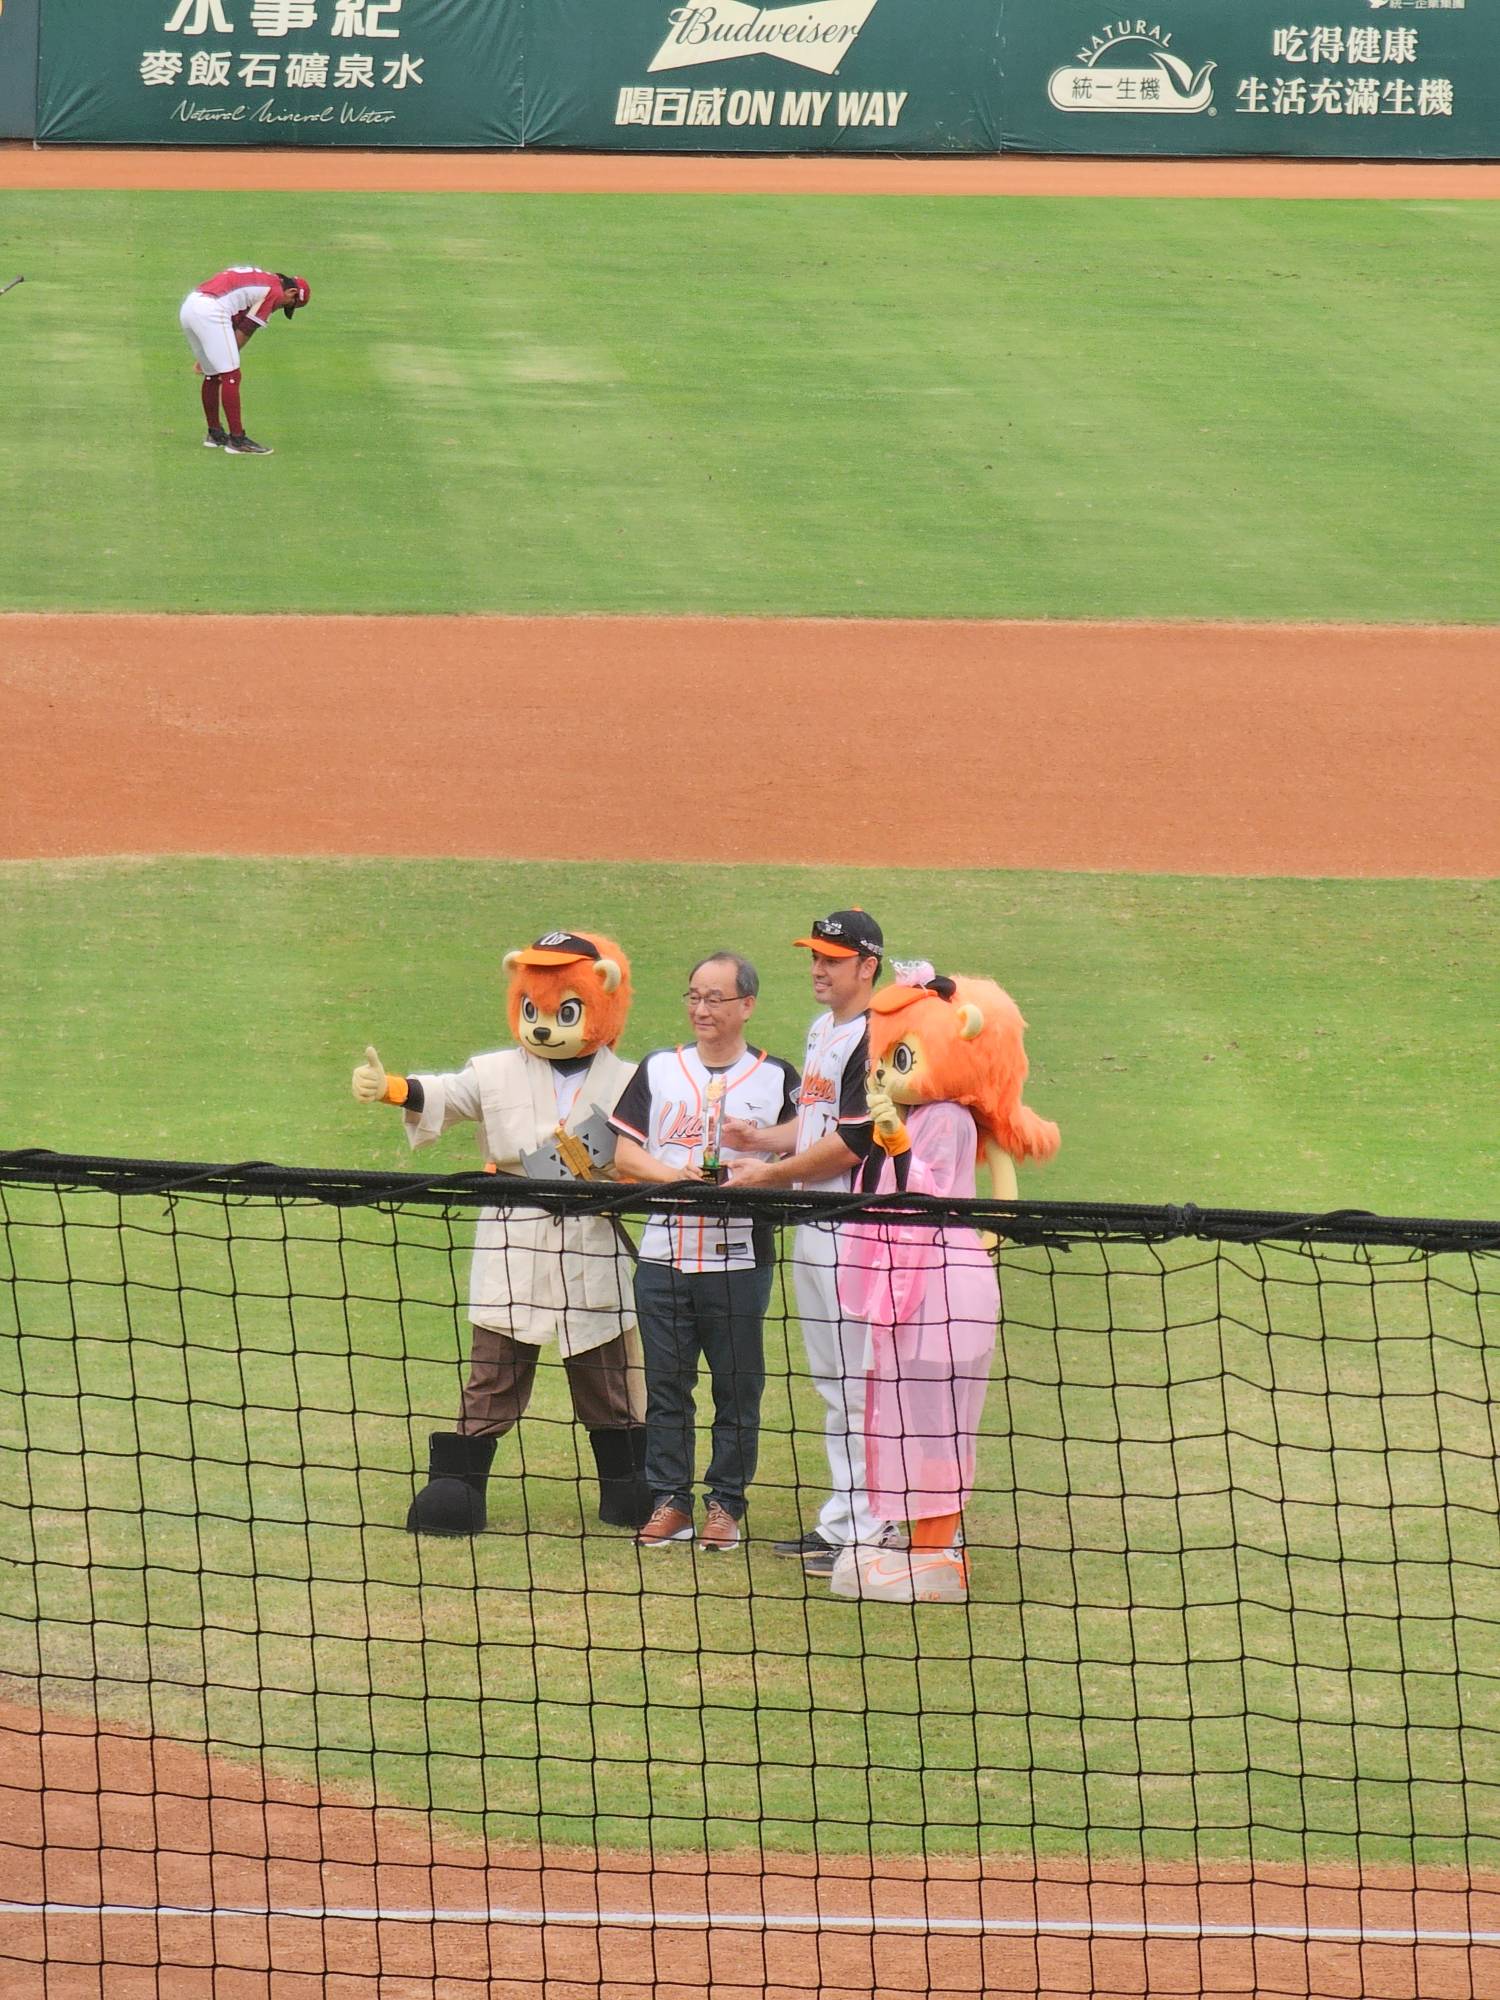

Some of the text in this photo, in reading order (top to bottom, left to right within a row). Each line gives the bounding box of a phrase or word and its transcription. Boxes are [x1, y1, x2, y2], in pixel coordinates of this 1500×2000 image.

[668, 6, 859, 46] Budweiser
[1076, 19, 1173, 63] NATURAL
[1272, 25, 1419, 64] 吃得健康
[139, 50, 425, 89] 麥飯石礦泉水
[1071, 76, 1161, 101] 統一生機
[170, 98, 397, 125] Natural Mineral Water
[614, 87, 908, 127] 喝百威 ON MY WAY
[1235, 76, 1454, 116] 生活充滿生機
